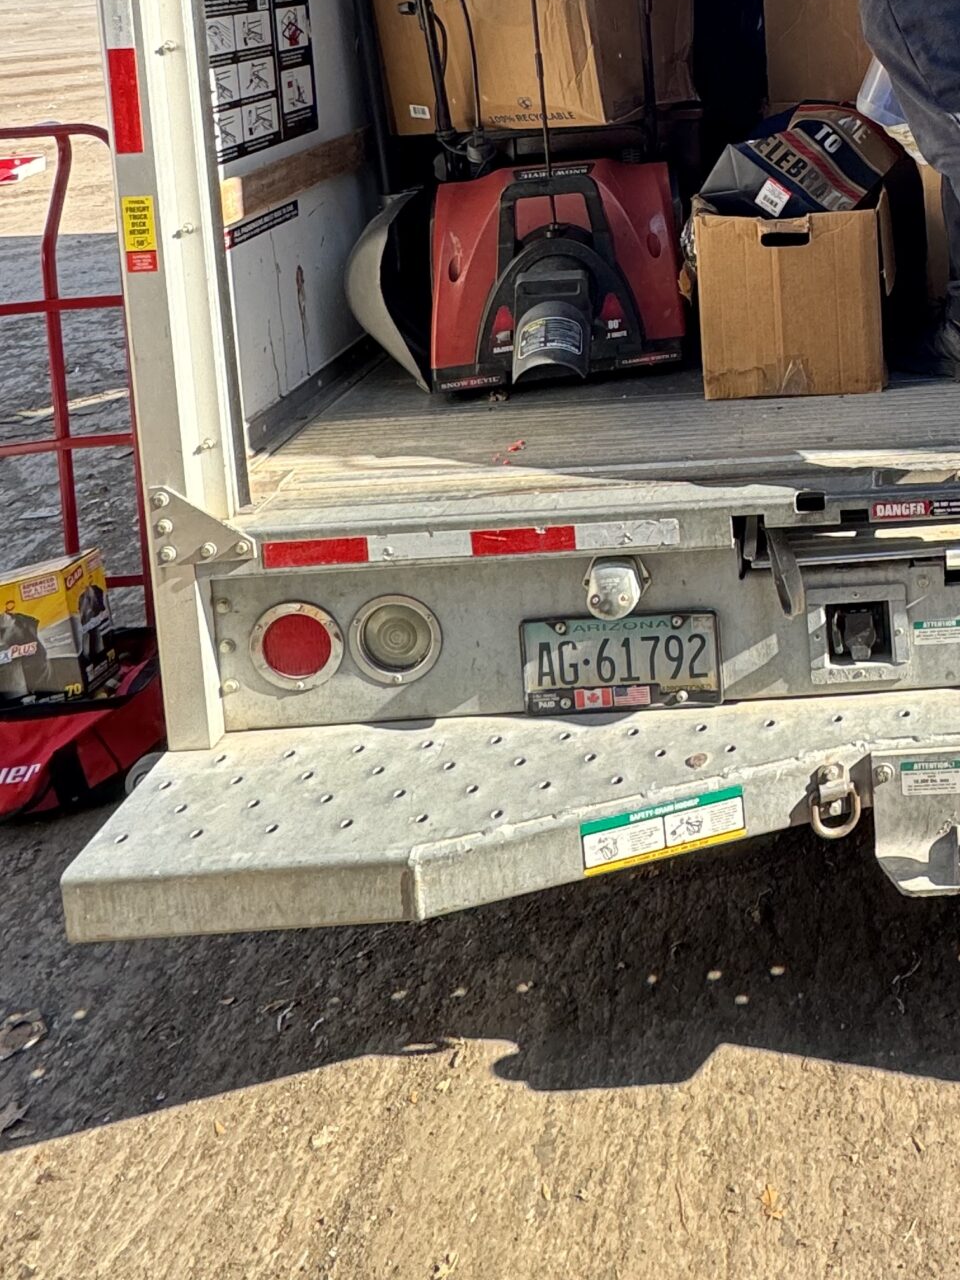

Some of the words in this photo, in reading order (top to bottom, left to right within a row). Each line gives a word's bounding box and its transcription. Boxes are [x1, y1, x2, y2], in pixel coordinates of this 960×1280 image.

[814, 124, 843, 154] TO
[754, 134, 854, 211] ELEBRAT
[441, 380, 469, 389] SNOW
[470, 376, 500, 385] DEVIL
[876, 503, 925, 517] DANGER
[573, 619, 669, 633] ARIZONA
[65, 683, 82, 697] 70
